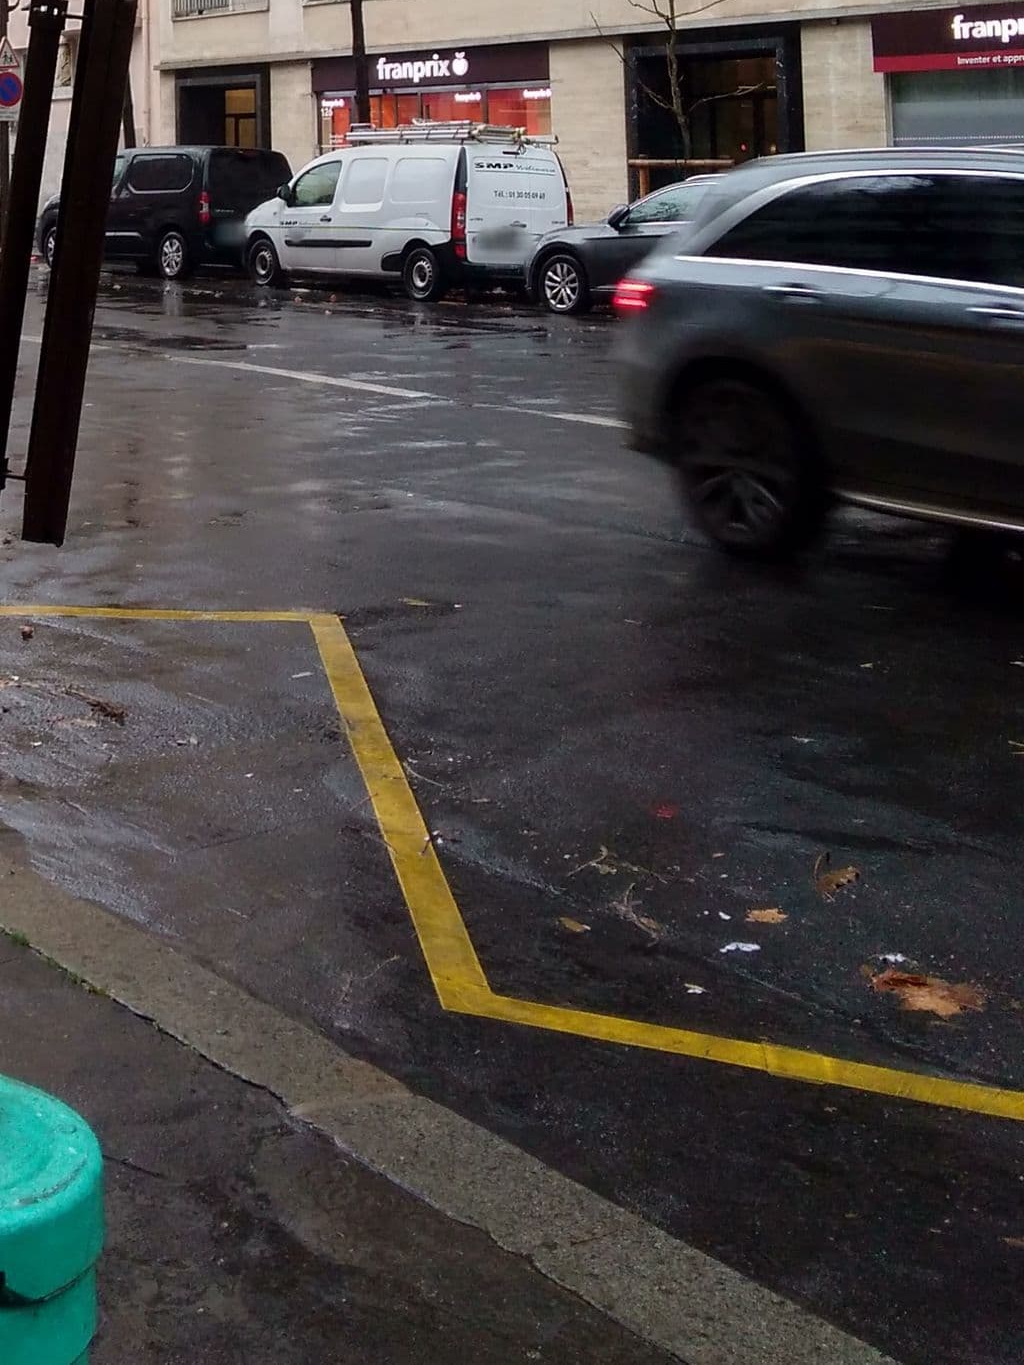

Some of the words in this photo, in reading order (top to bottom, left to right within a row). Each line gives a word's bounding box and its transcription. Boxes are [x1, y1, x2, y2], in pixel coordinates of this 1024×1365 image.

[376, 53, 451, 83] franprix
[957, 55, 991, 65] Inventer
[992, 54, 1002, 63] et
